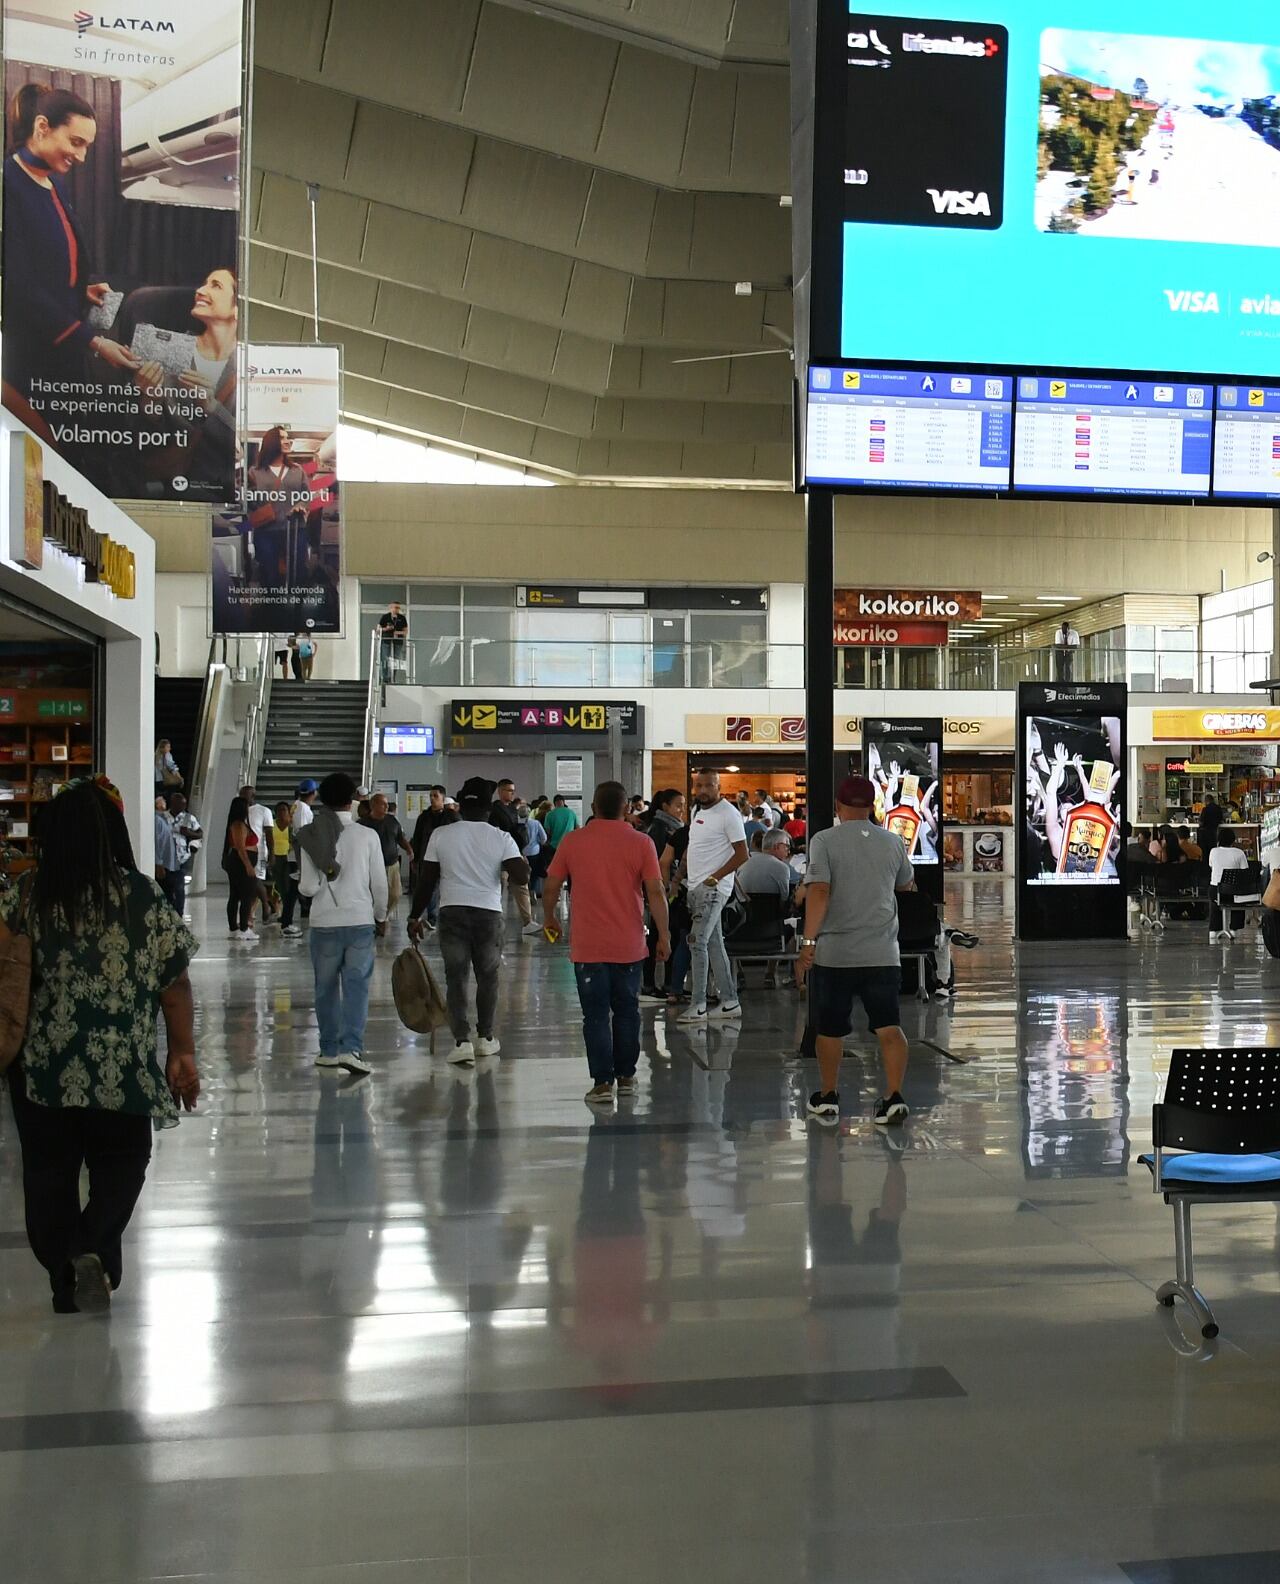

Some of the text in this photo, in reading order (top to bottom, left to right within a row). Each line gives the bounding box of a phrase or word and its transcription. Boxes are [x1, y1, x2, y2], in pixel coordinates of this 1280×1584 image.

[100, 17, 175, 33] LATAM
[74, 47, 175, 66] Sin fronteras
[926, 188, 991, 216] VISA
[1163, 289, 1220, 313] VISA
[261, 367, 302, 375] LATAM
[30, 377, 208, 400] Hacemos más cómoda
[263, 385, 302, 394] fronteras
[28, 396, 208, 421] tu experiencia de viaje.
[49, 423, 188, 450] Volamos por ti
[235, 486, 329, 505] olamos por ti
[228, 585, 324, 594] Hacemos más cómoda
[240, 597, 288, 605] experiencia
[289, 596, 300, 604] de
[302, 597, 325, 606] viaje.
[859, 594, 960, 616] kokoriko
[834, 624, 899, 642] koriko
[524, 711, 538, 724] A
[549, 711, 559, 723] B
[944, 717, 980, 733] icos
[1202, 712, 1267, 731] GINEBRAS
[1167, 763, 1186, 771] Coffe
